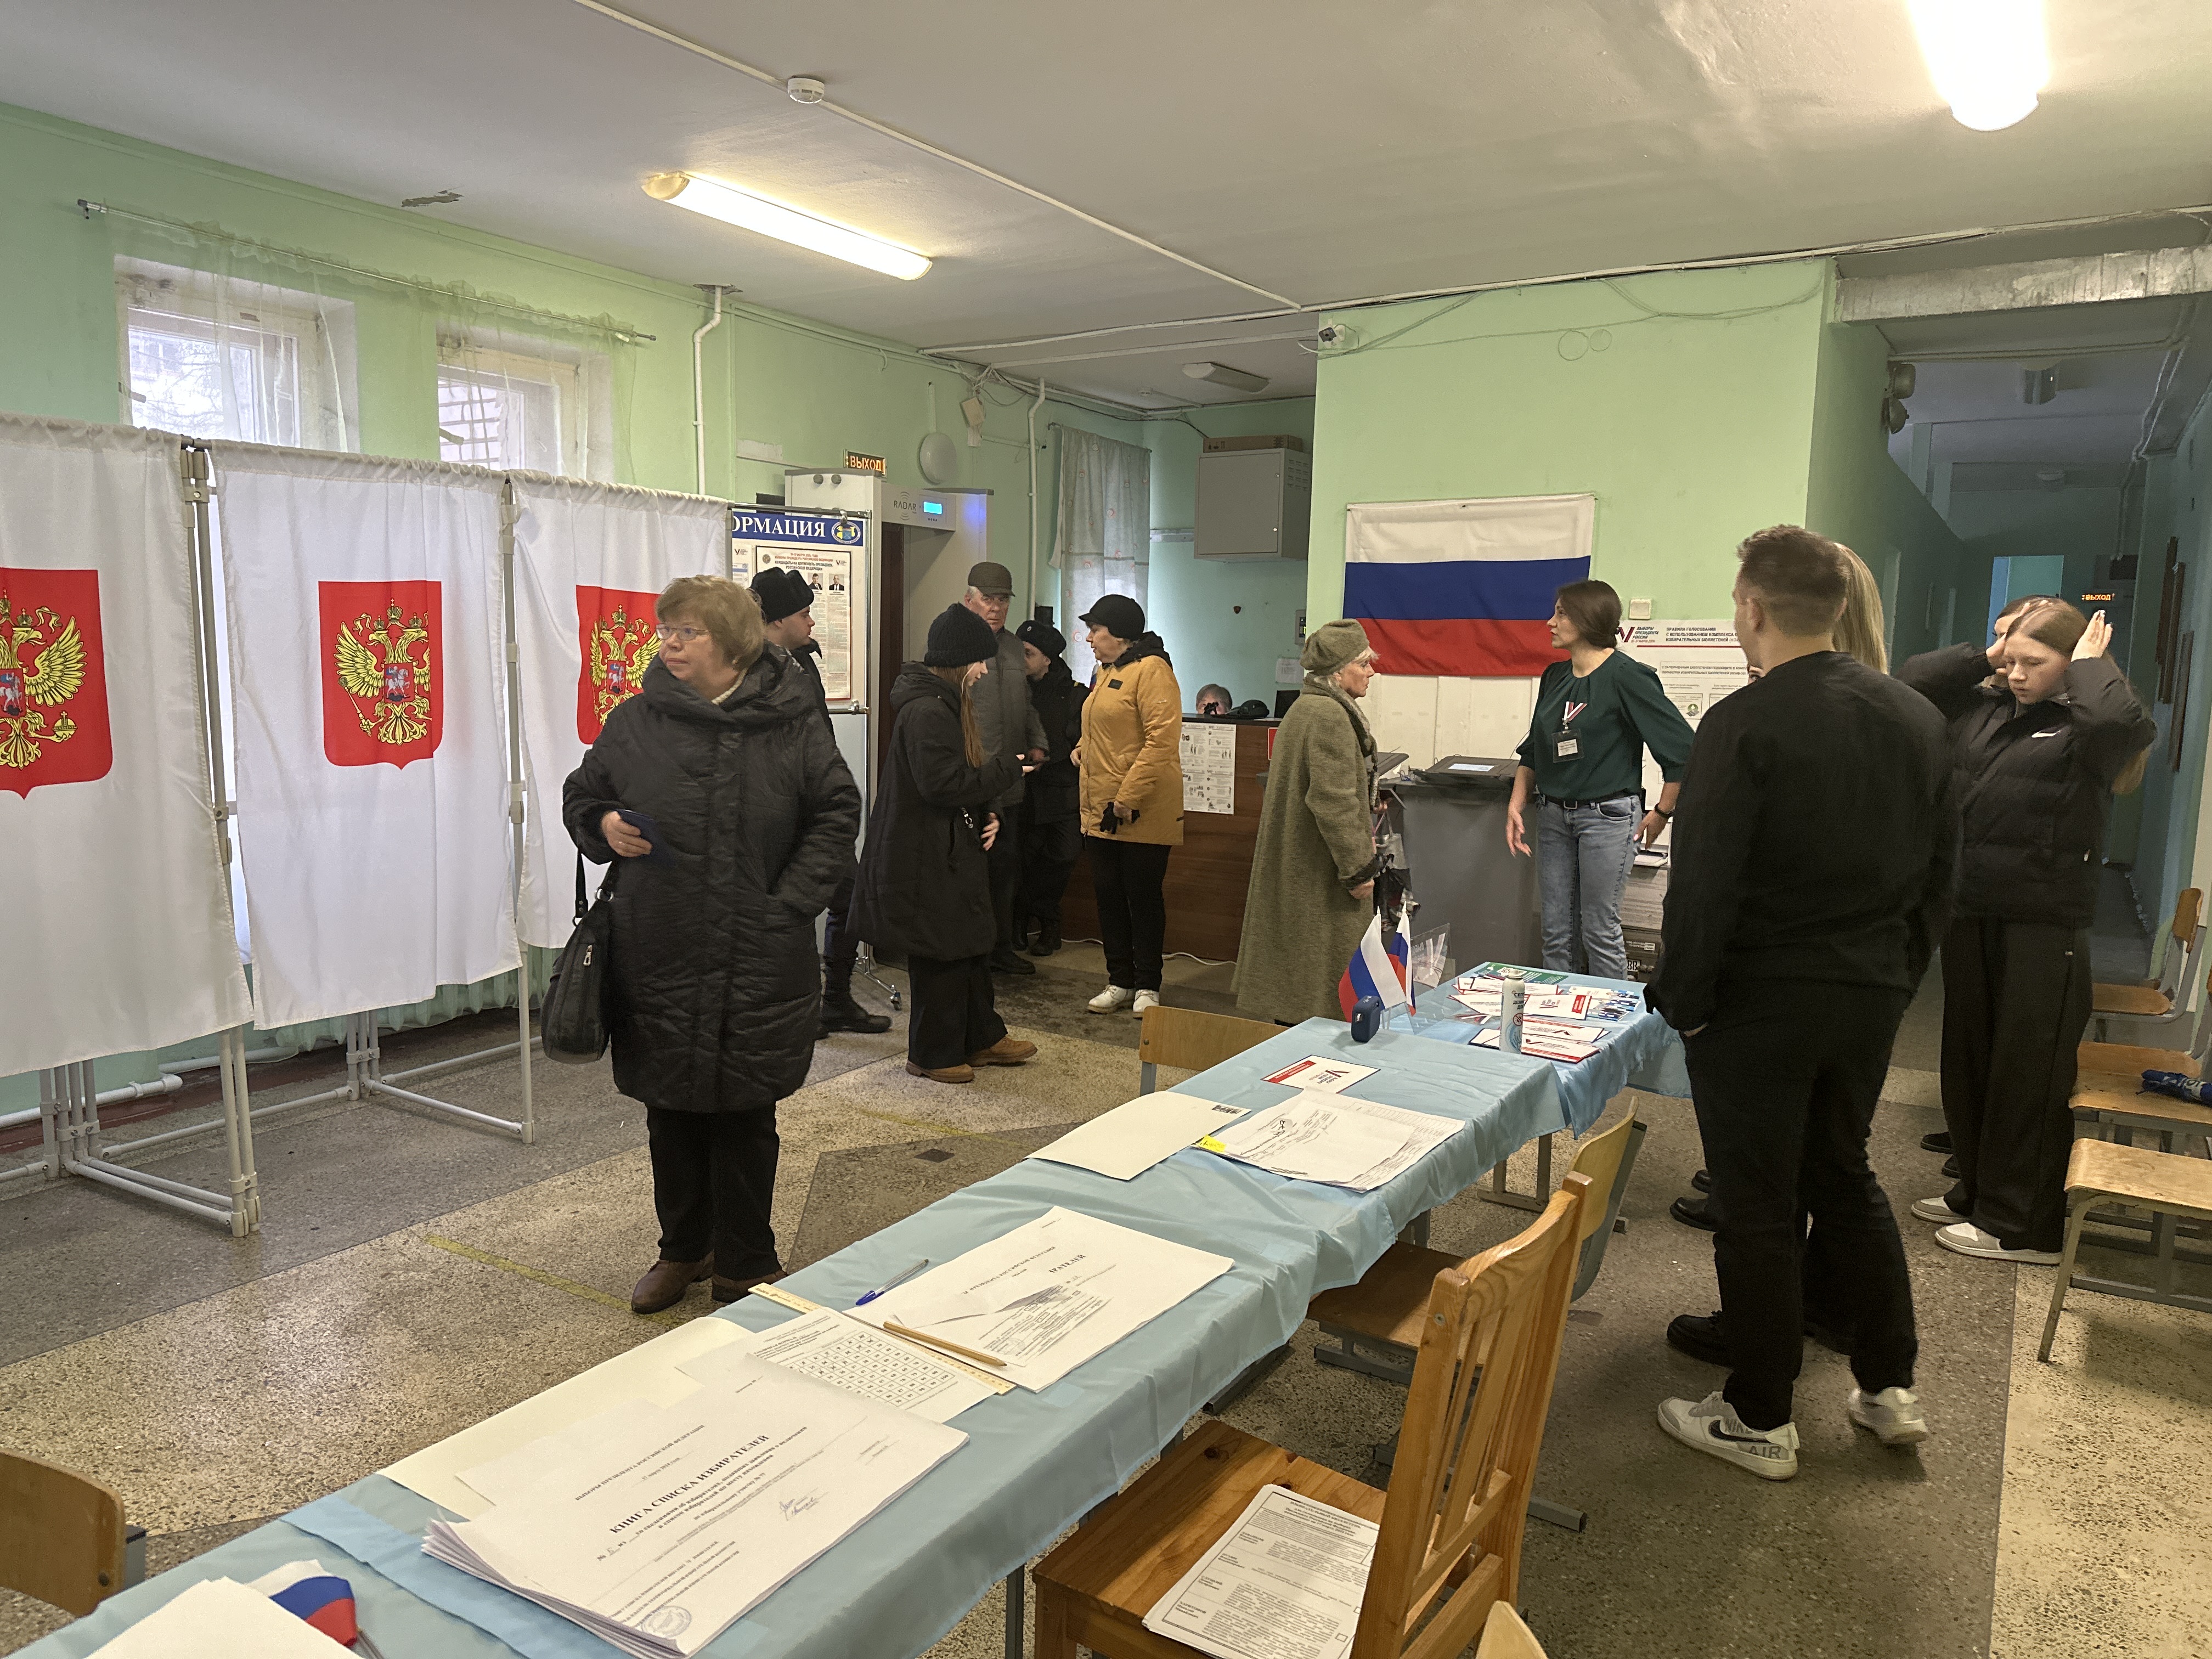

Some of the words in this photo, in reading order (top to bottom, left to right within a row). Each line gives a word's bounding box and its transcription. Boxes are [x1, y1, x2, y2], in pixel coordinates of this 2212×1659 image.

[850, 455, 882, 471] ВЫХОД
[894, 500, 916, 511] RADAR
[1000, 1259, 1030, 1276] РОССИЙСКОЙ
[1748, 1445, 1781, 1459] AIR
[610, 1509, 652, 1533] КНИГА
[652, 1482, 698, 1506] СПИСКА
[697, 1436, 769, 1480] ИЗБИРАТЕЛЕЙ
